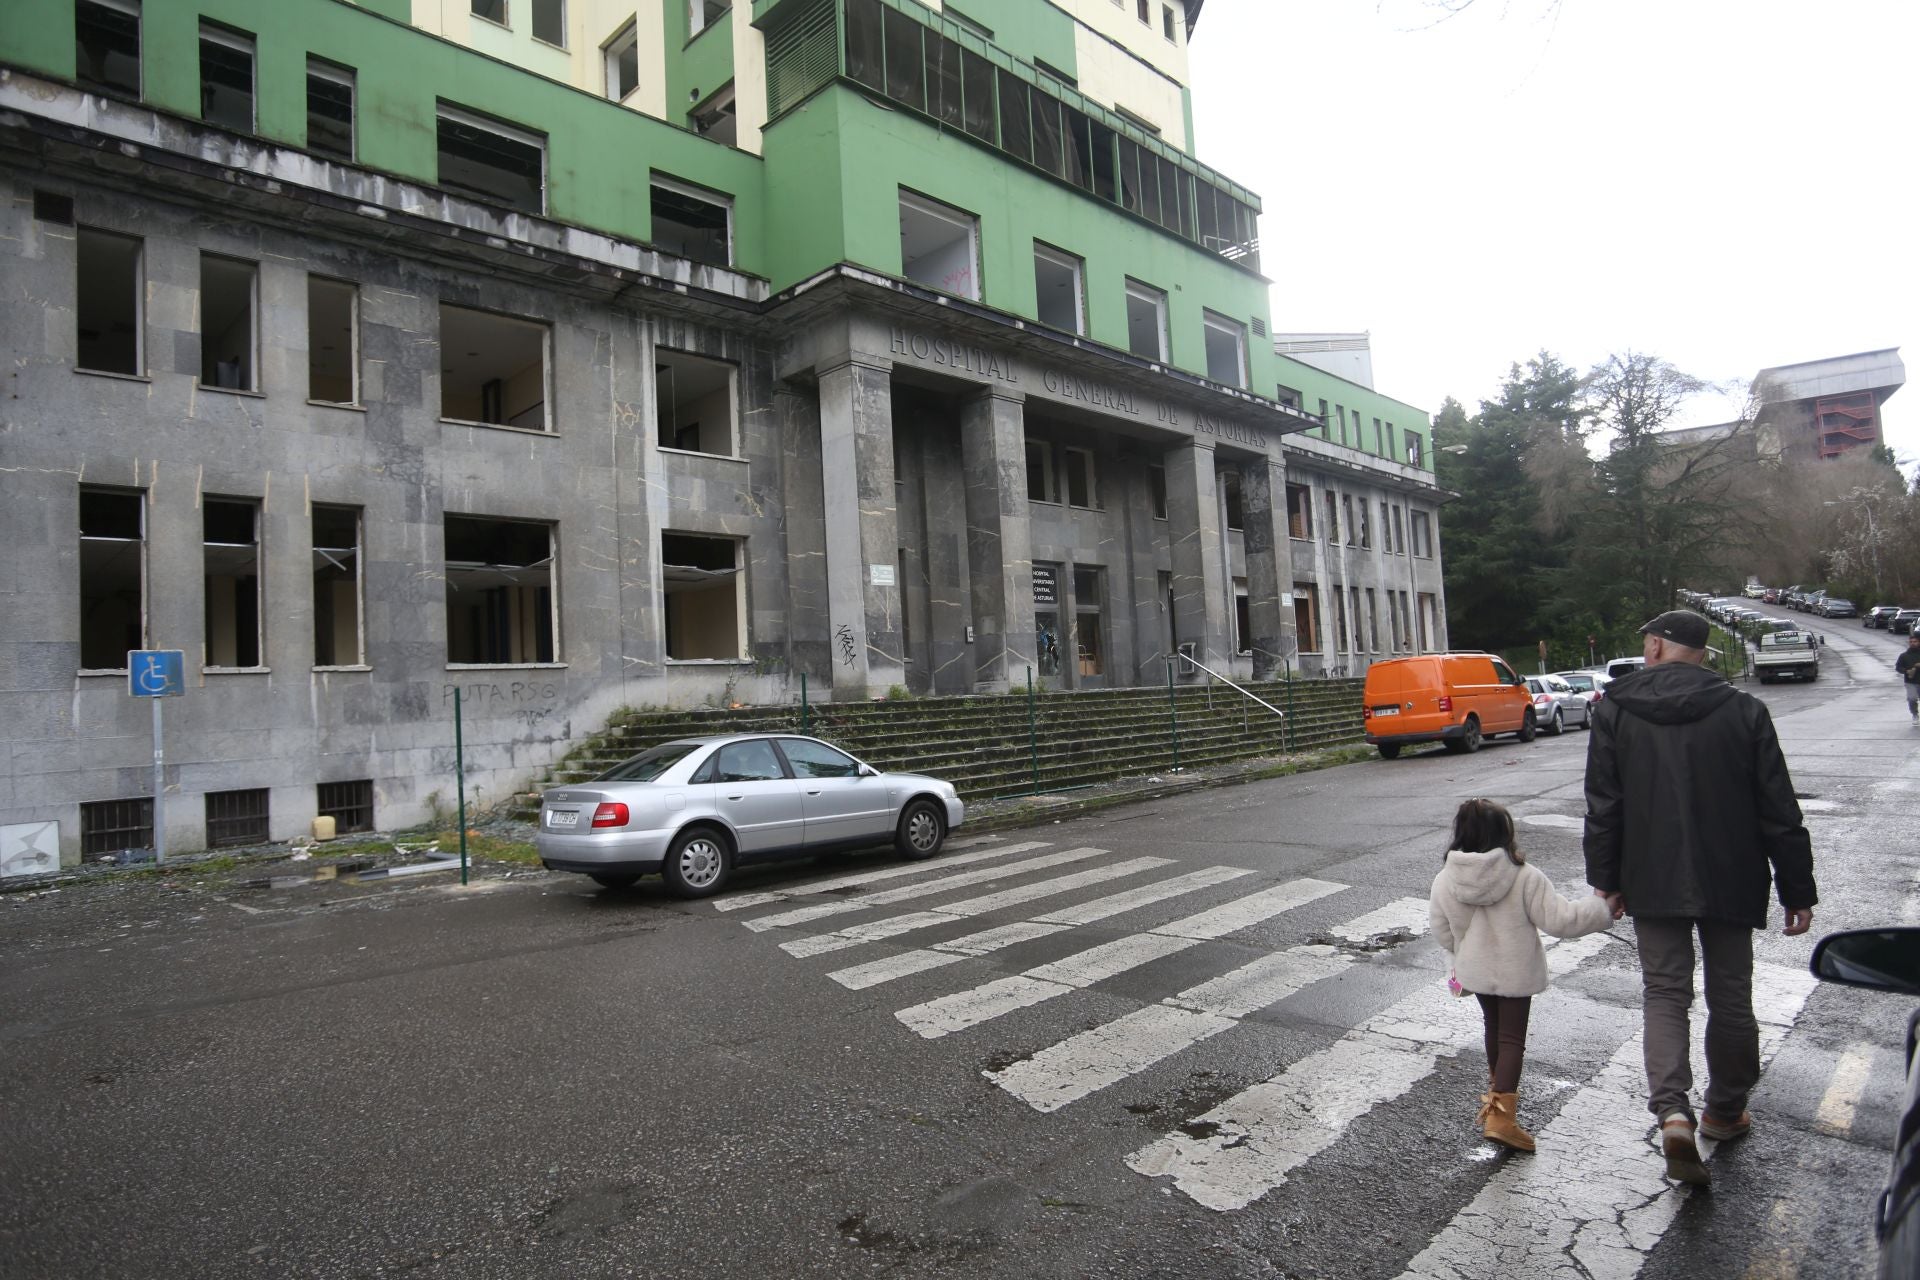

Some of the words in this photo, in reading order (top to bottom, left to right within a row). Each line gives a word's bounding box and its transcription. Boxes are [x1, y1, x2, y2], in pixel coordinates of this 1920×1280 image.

[889, 327, 1017, 383] HOSPITAL
[1043, 366, 1140, 415] GENERAL
[1156, 401, 1179, 426] DE
[1194, 411, 1267, 449] ASTURIAS
